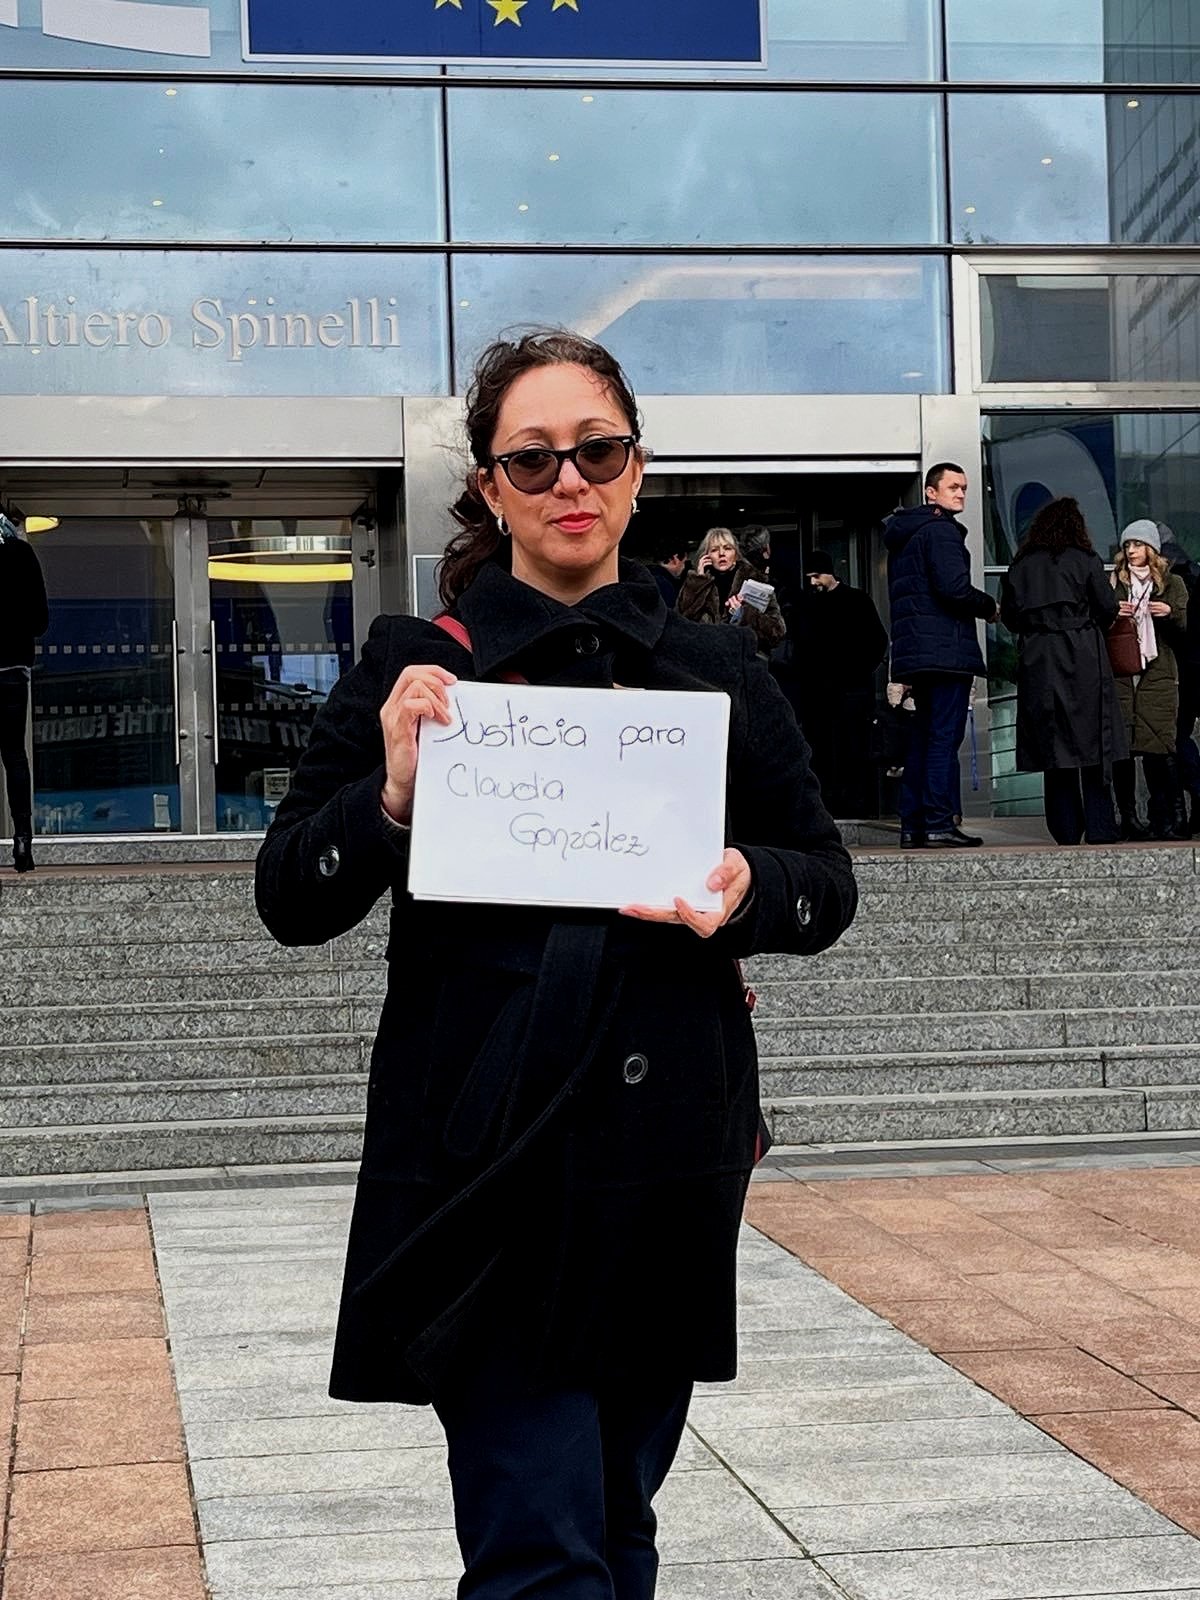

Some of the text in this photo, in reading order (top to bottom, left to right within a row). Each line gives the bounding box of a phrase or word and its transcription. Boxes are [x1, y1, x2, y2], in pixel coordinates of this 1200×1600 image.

[191, 297, 400, 363] Spinelli
[432, 697, 687, 761] Justicia para
[446, 763, 565, 801] Claudia
[508, 811, 650, 861] González
